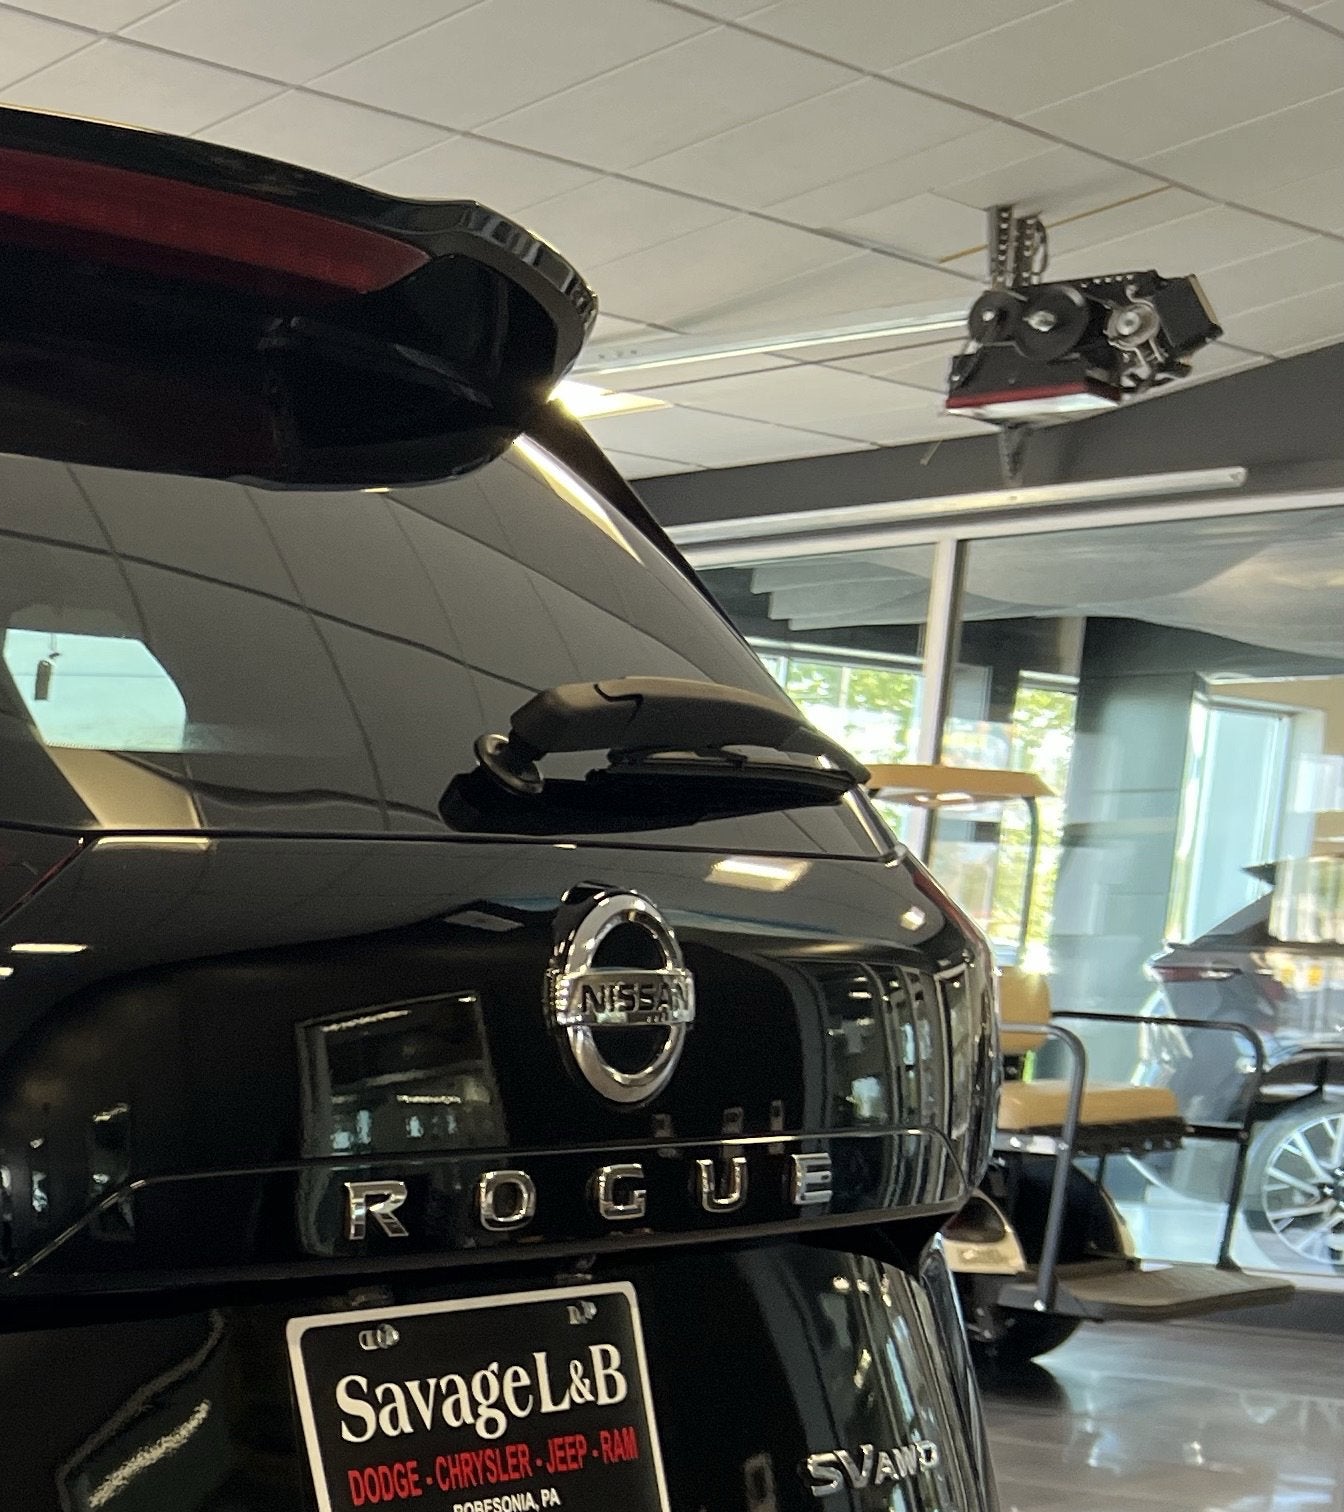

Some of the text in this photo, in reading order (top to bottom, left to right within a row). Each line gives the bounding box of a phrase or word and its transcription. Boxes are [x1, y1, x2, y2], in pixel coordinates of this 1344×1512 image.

[581, 983, 690, 1013] NISSAN
[343, 1152, 832, 1241] ROGUE
[347, 1460, 423, 1507] DODGE
[435, 1444, 533, 1492] CHRYSLER
[545, 1434, 588, 1474] JEEP
[600, 1426, 639, 1464] RAM
[541, 1487, 561, 1507] PA
